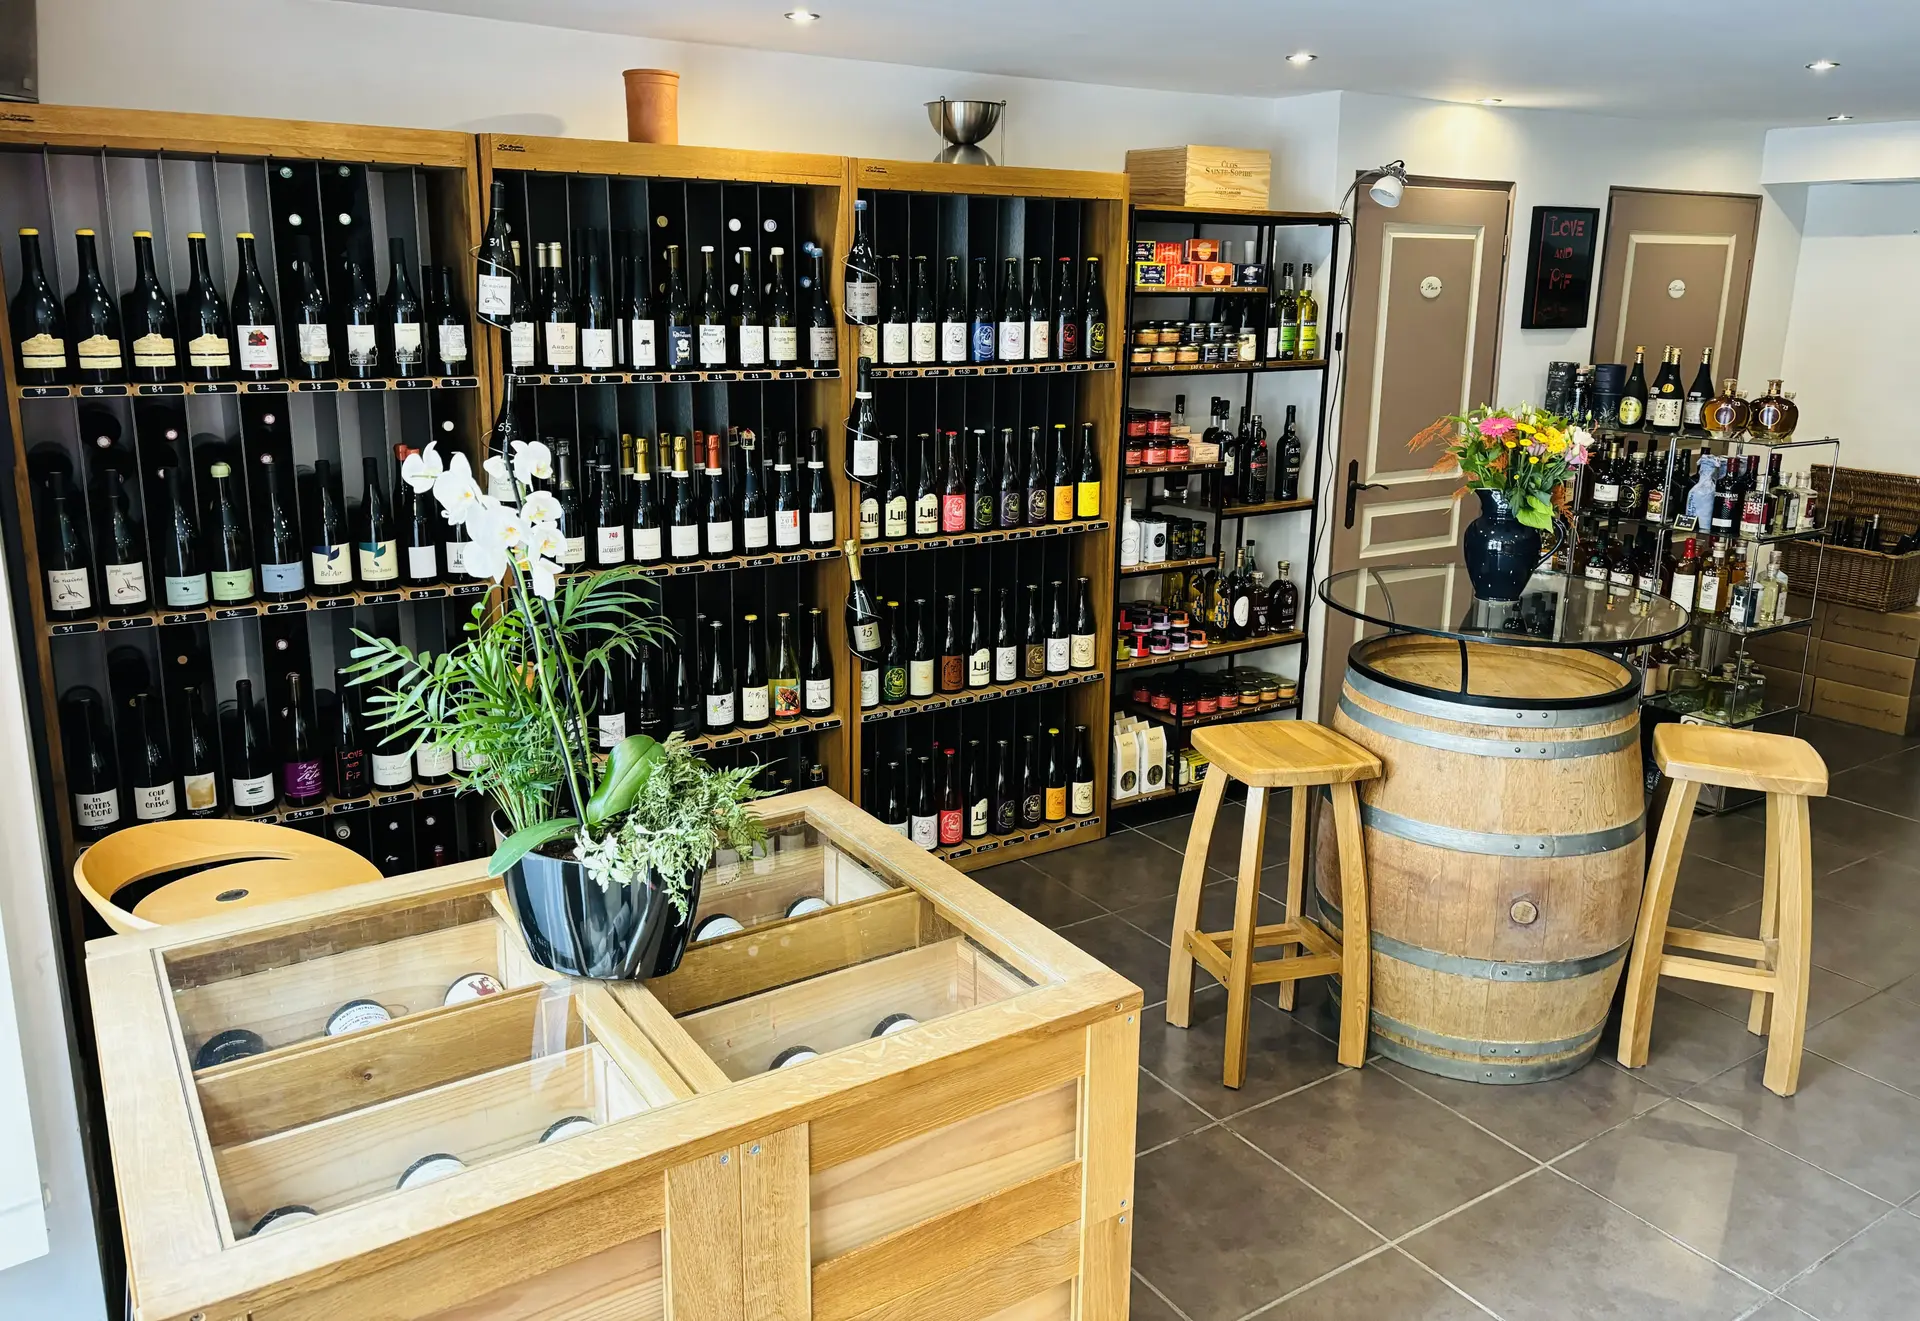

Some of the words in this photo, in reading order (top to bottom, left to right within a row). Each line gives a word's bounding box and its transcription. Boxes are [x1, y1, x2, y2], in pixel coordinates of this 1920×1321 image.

[1549, 215, 1586, 238] LOVE
[1554, 247, 1573, 260] AND
[339, 749, 364, 760] LOVE
[148, 789, 166, 798] COUP
